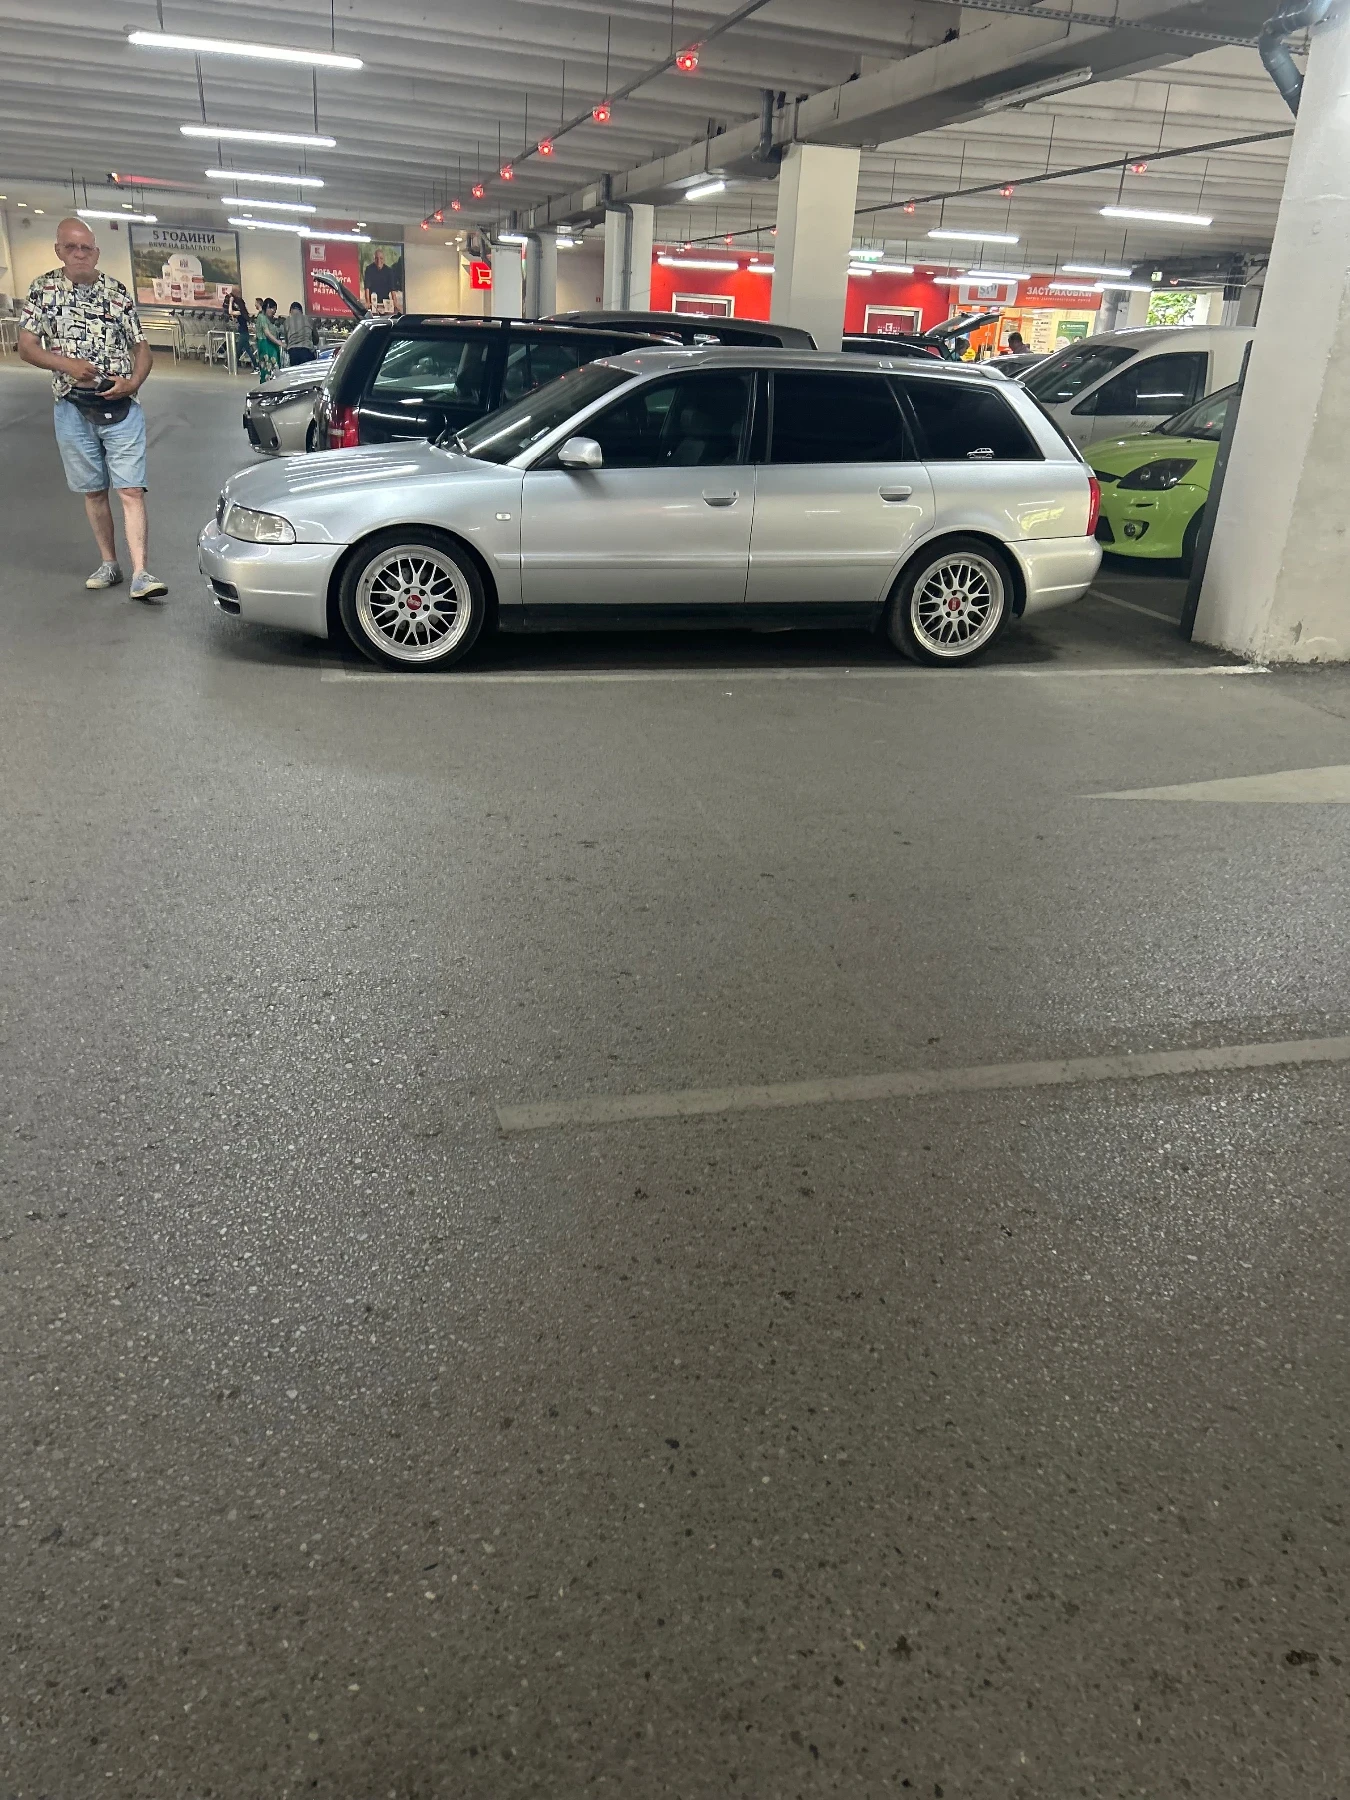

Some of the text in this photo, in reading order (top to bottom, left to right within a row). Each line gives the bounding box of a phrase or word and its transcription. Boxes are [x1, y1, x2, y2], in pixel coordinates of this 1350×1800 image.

[152, 230, 215, 244] 5 ГОДИНИ
[1026, 286, 1092, 297] ЗАСТРАХОВКИ
